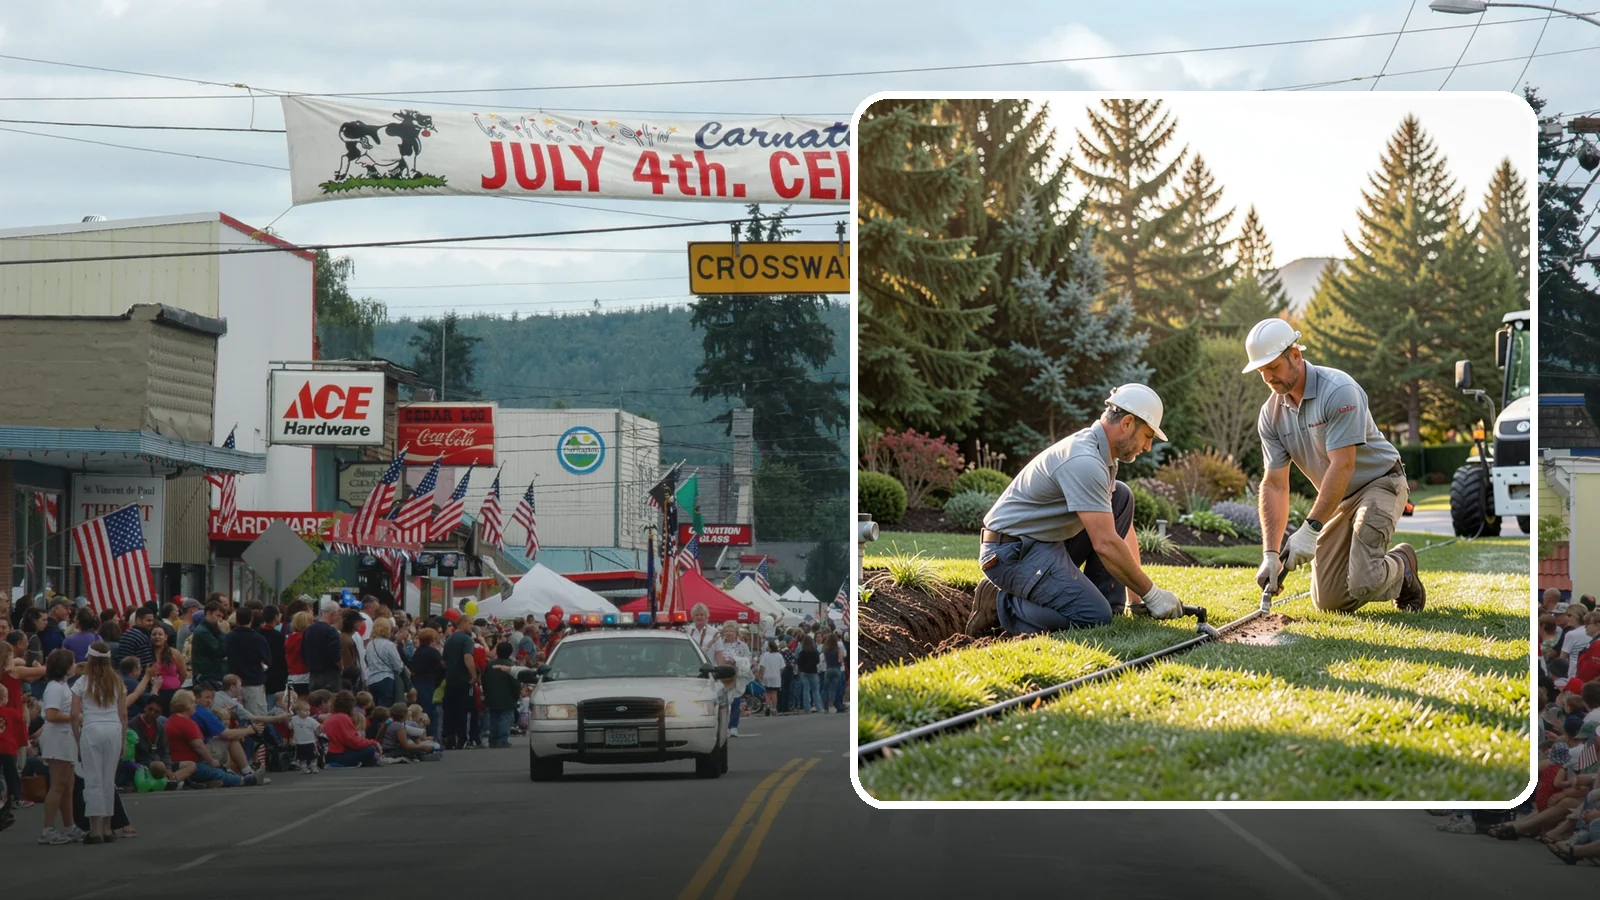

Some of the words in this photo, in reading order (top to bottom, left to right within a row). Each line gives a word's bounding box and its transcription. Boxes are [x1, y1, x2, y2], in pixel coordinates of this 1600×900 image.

[481, 141, 604, 192] JULY
[632, 150, 746, 197] 4th.
[697, 254, 850, 280] CROSSWA
[283, 380, 373, 420] ACE
[405, 409, 453, 422] CEDAR
[283, 421, 371, 436] Hardware
[137, 487, 155, 495] Paul
[699, 535, 730, 543] GLASS
